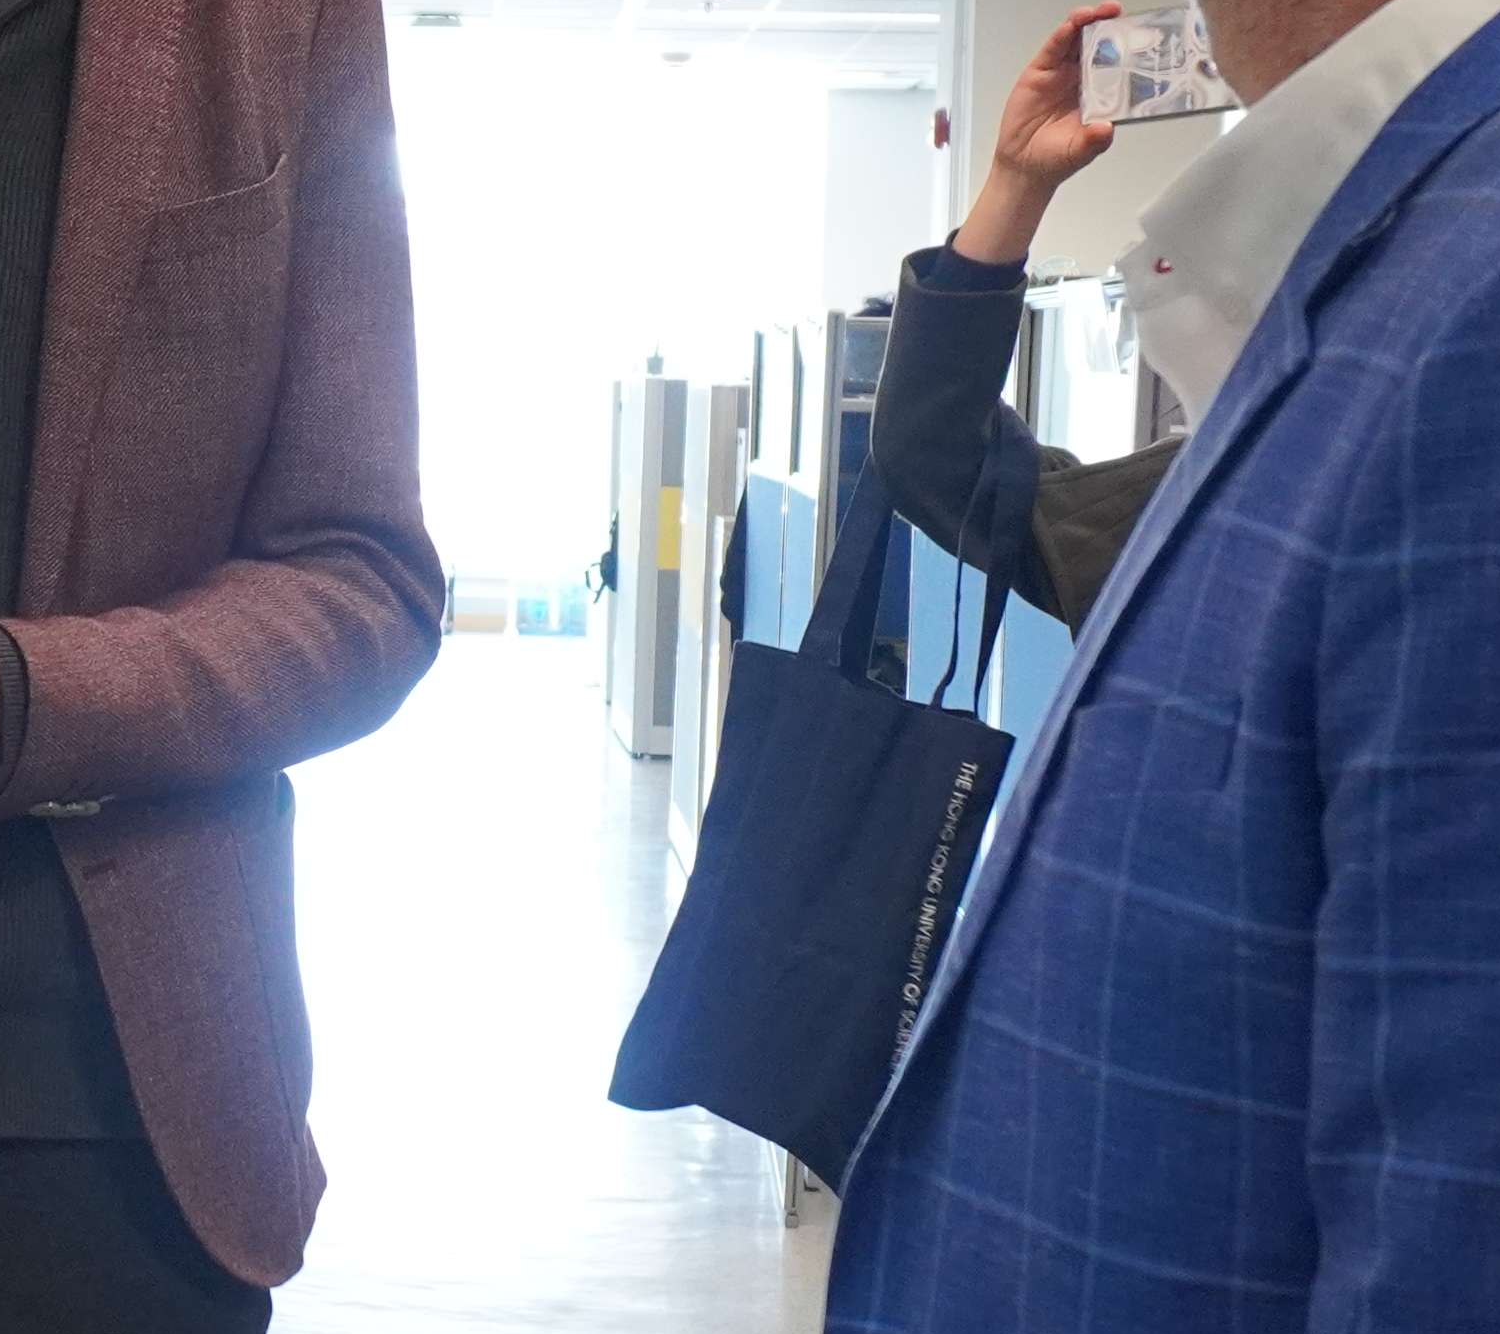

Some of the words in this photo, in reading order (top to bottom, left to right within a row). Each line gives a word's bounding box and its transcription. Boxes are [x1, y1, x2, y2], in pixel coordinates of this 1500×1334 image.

[955, 761, 978, 792] THE
[940, 791, 968, 842] HONG
[926, 844, 951, 895] KONG
[907, 897, 938, 982] UNIVERSITY
[902, 982, 921, 1007] OF
